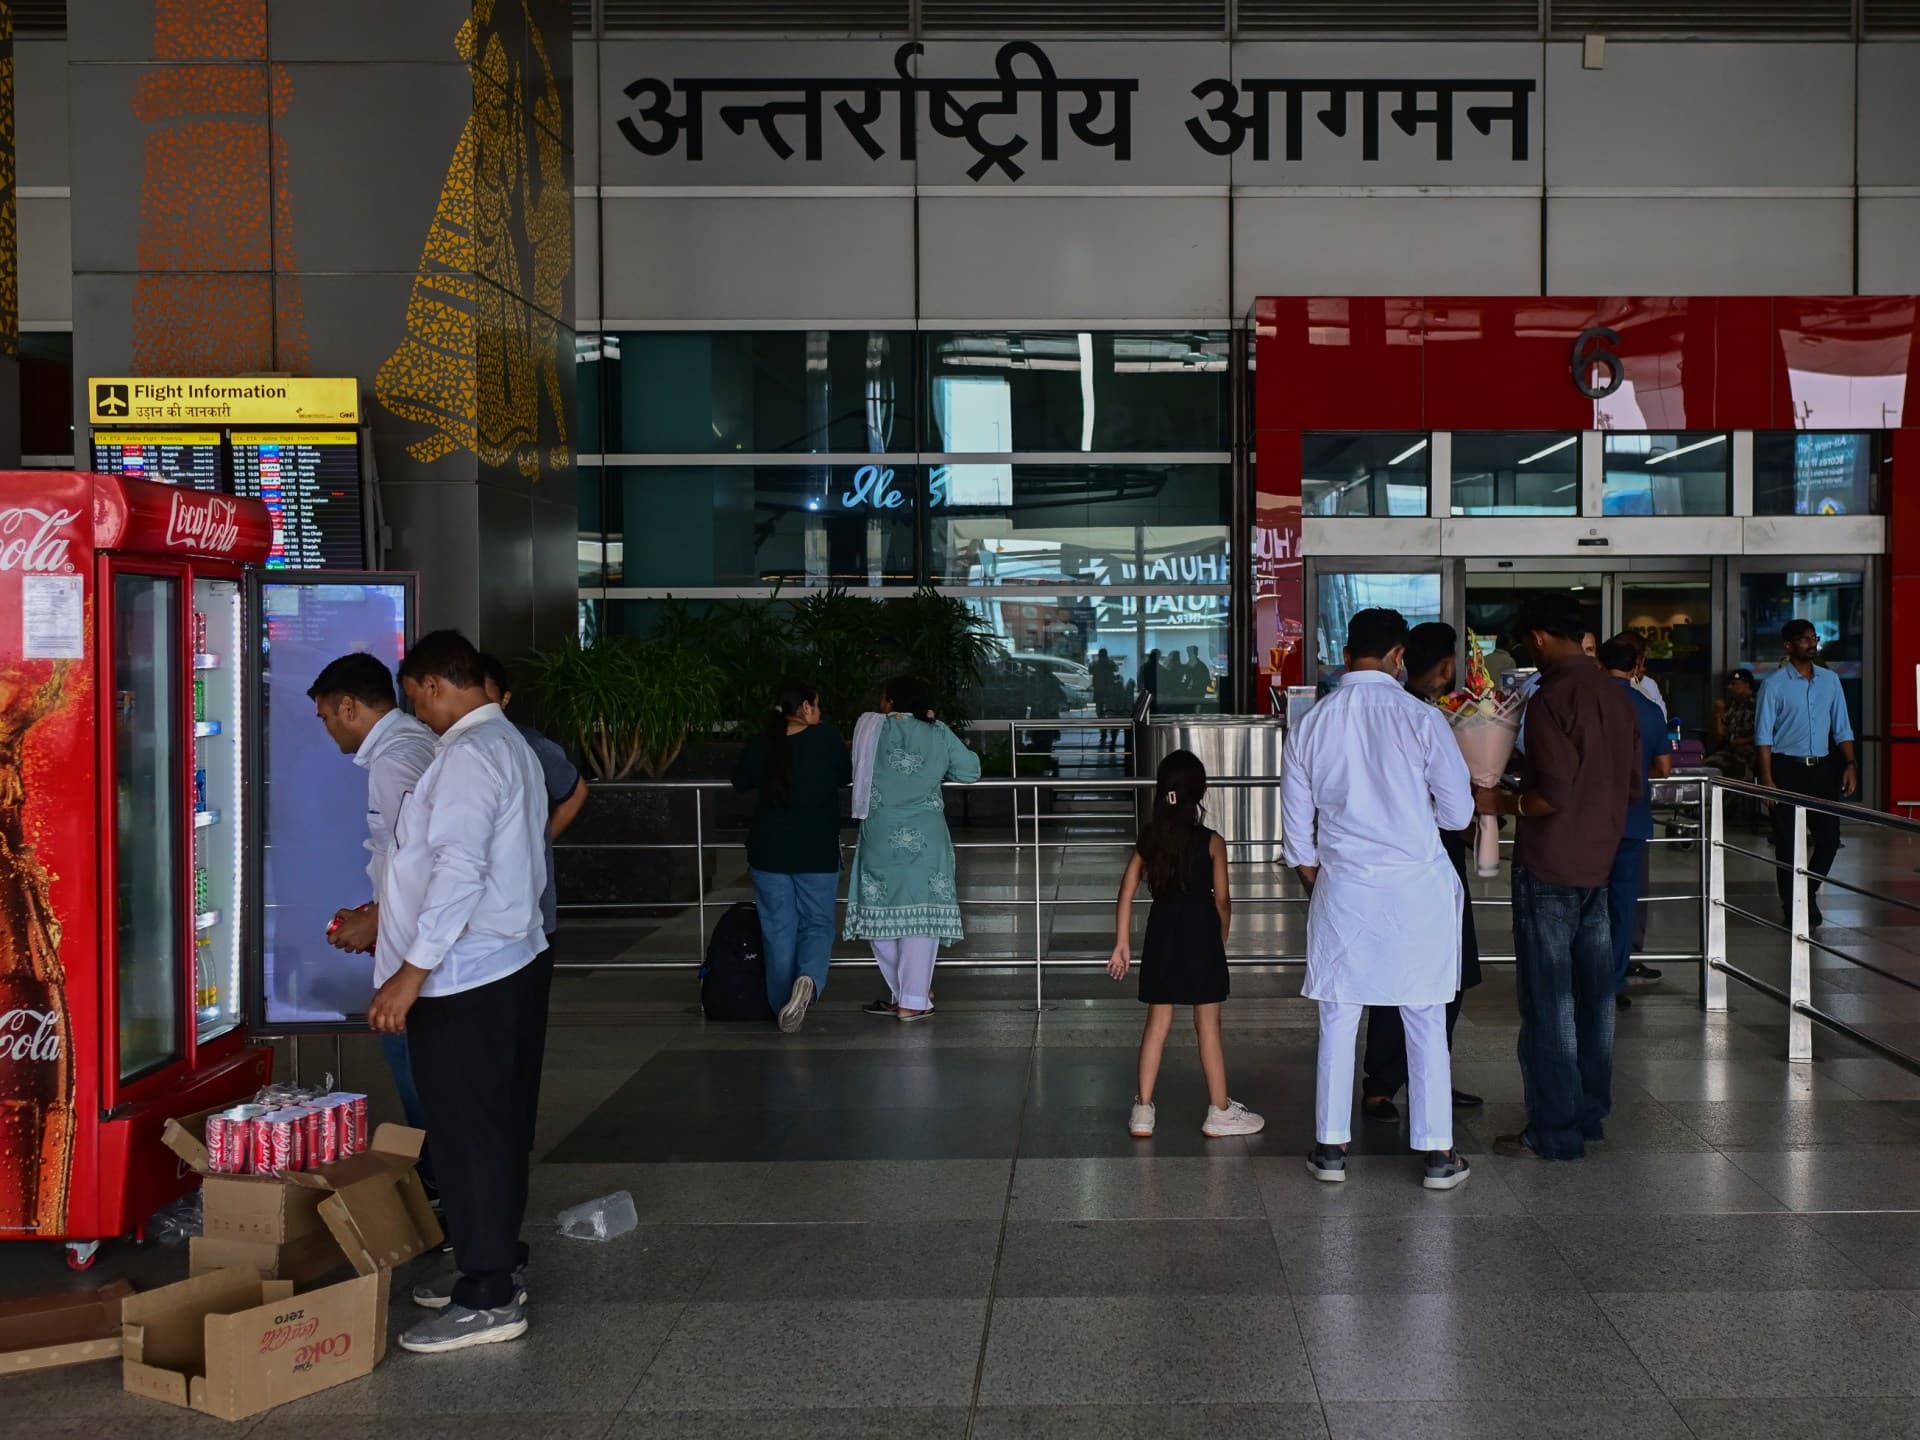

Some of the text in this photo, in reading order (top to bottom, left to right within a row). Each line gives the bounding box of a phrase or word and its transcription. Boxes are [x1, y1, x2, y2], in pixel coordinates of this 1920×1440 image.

[1185, 78, 1536, 161] आगमन
[1570, 327, 1625, 399] 6
[134, 385, 286, 401] Flight Information
[135, 402, 231, 419] उड़ान की जानकारी
[274, 1309, 305, 1325] zero
[294, 1332, 351, 1364] Coke
